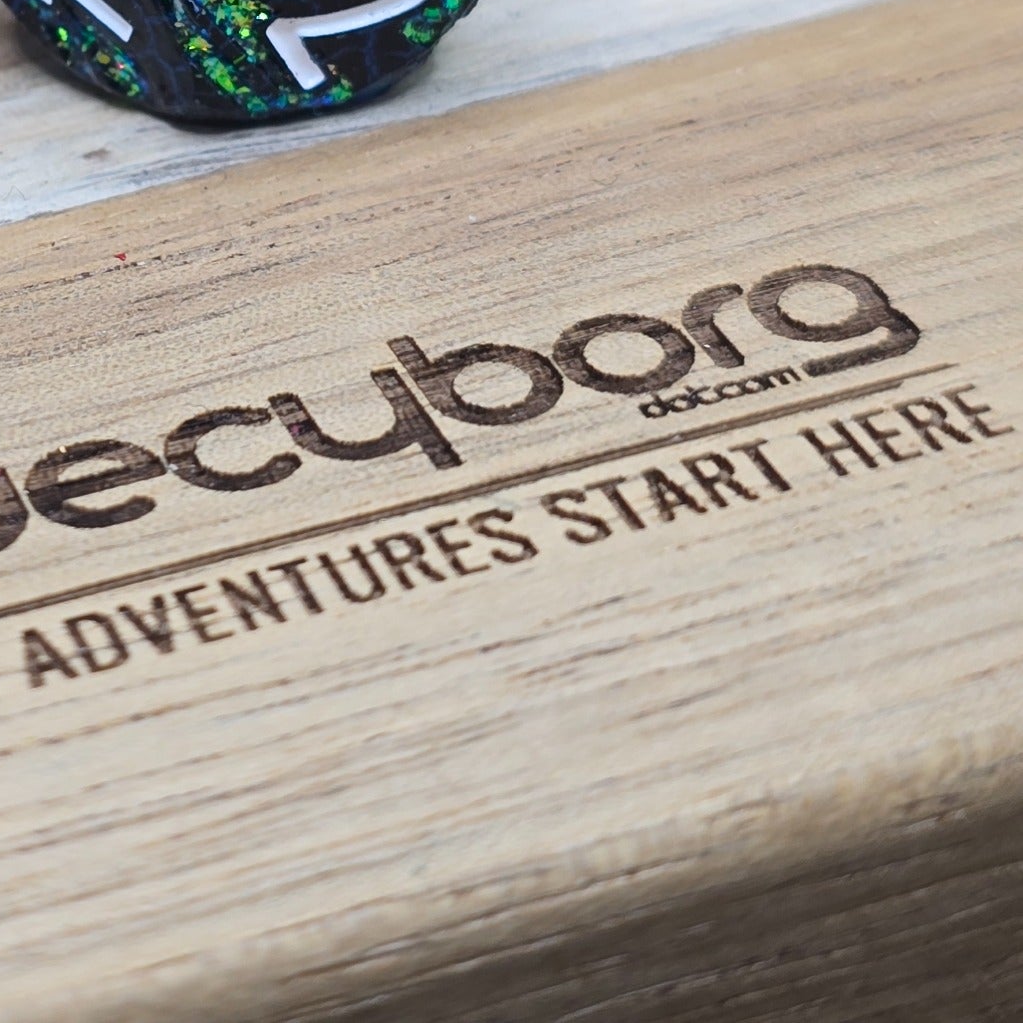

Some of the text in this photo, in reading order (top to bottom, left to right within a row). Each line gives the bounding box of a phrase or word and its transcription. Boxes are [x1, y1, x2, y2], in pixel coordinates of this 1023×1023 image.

[20, 506, 540, 690] ADVENTURES
[539, 438, 794, 547] START
[798, 383, 1014, 478] HERE
